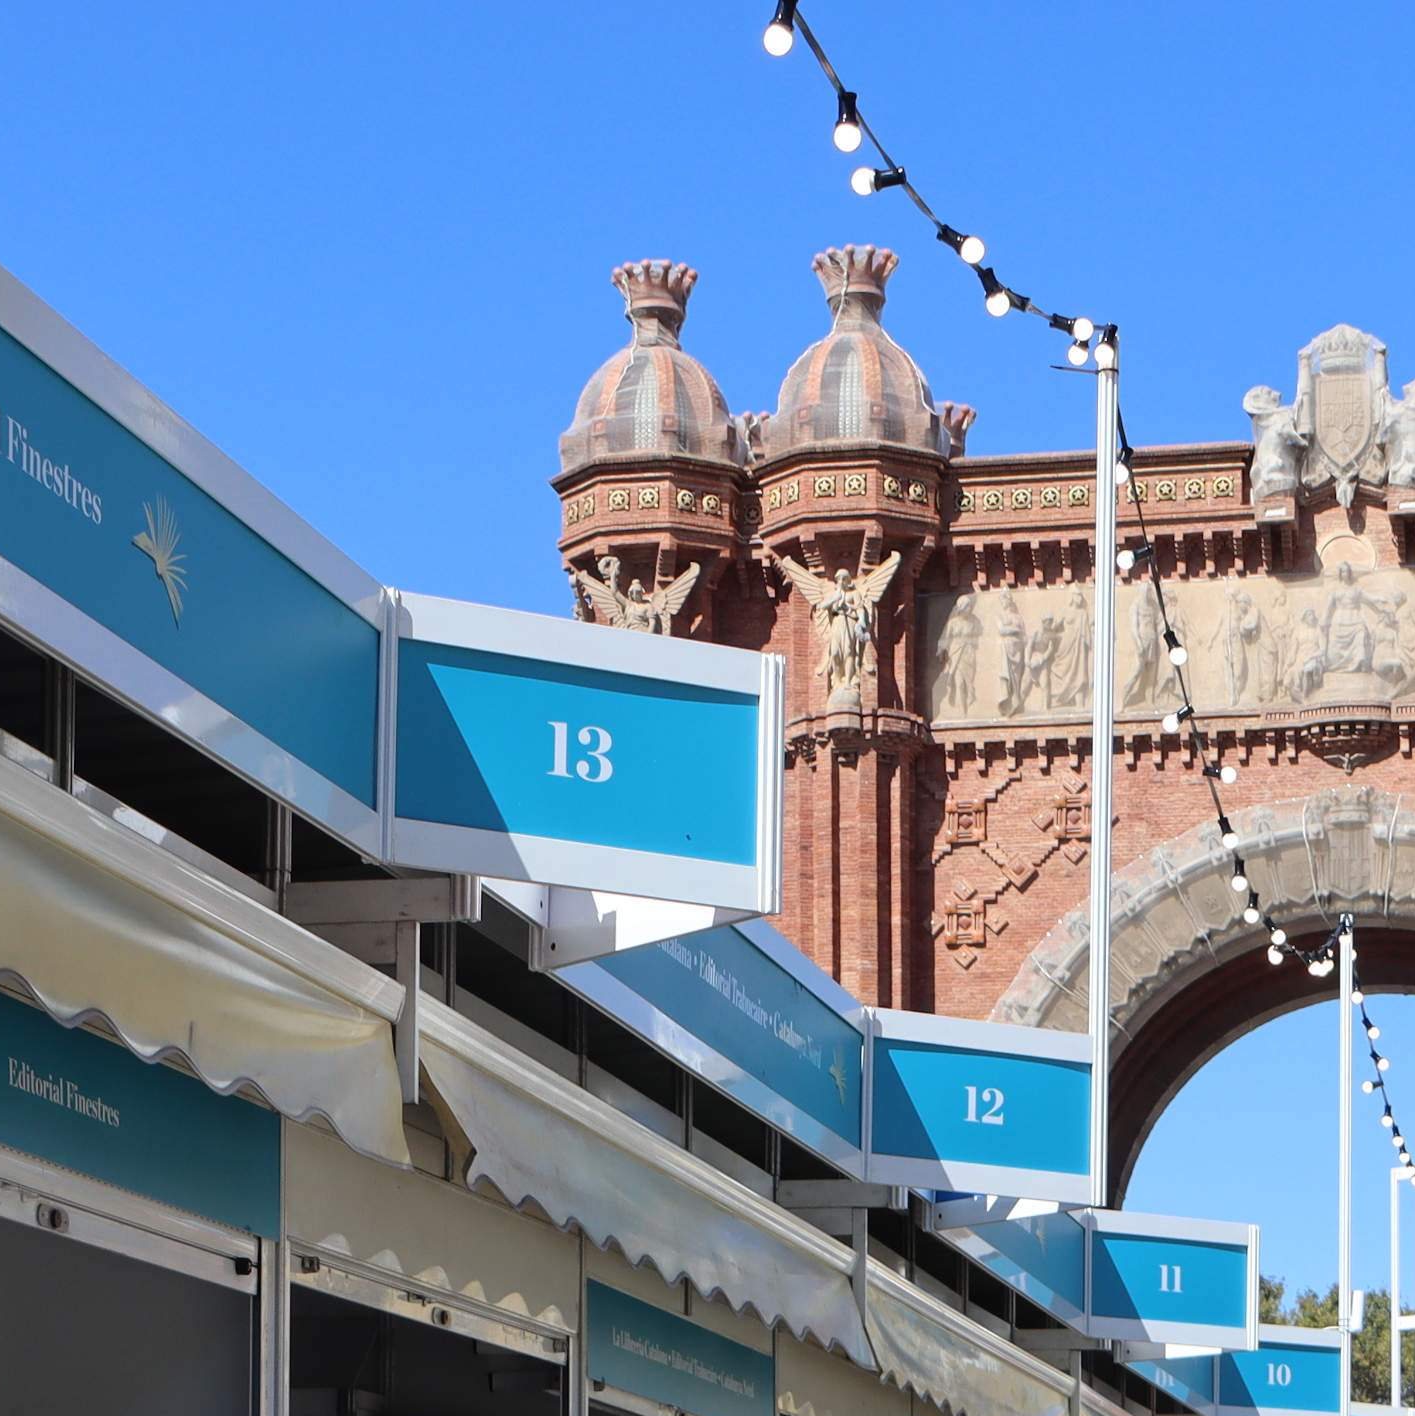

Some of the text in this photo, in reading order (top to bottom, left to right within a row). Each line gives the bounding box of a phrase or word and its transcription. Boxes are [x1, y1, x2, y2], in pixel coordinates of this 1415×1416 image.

[5, 413, 102, 526] Finestres
[546, 720, 614, 783] 13
[699, 950, 731, 1001] Editorial
[7, 1056, 121, 1129] Editorial Finestres
[963, 1085, 1005, 1125] 12
[1159, 1263, 1183, 1293] 11
[1266, 1362, 1292, 1387] 10
